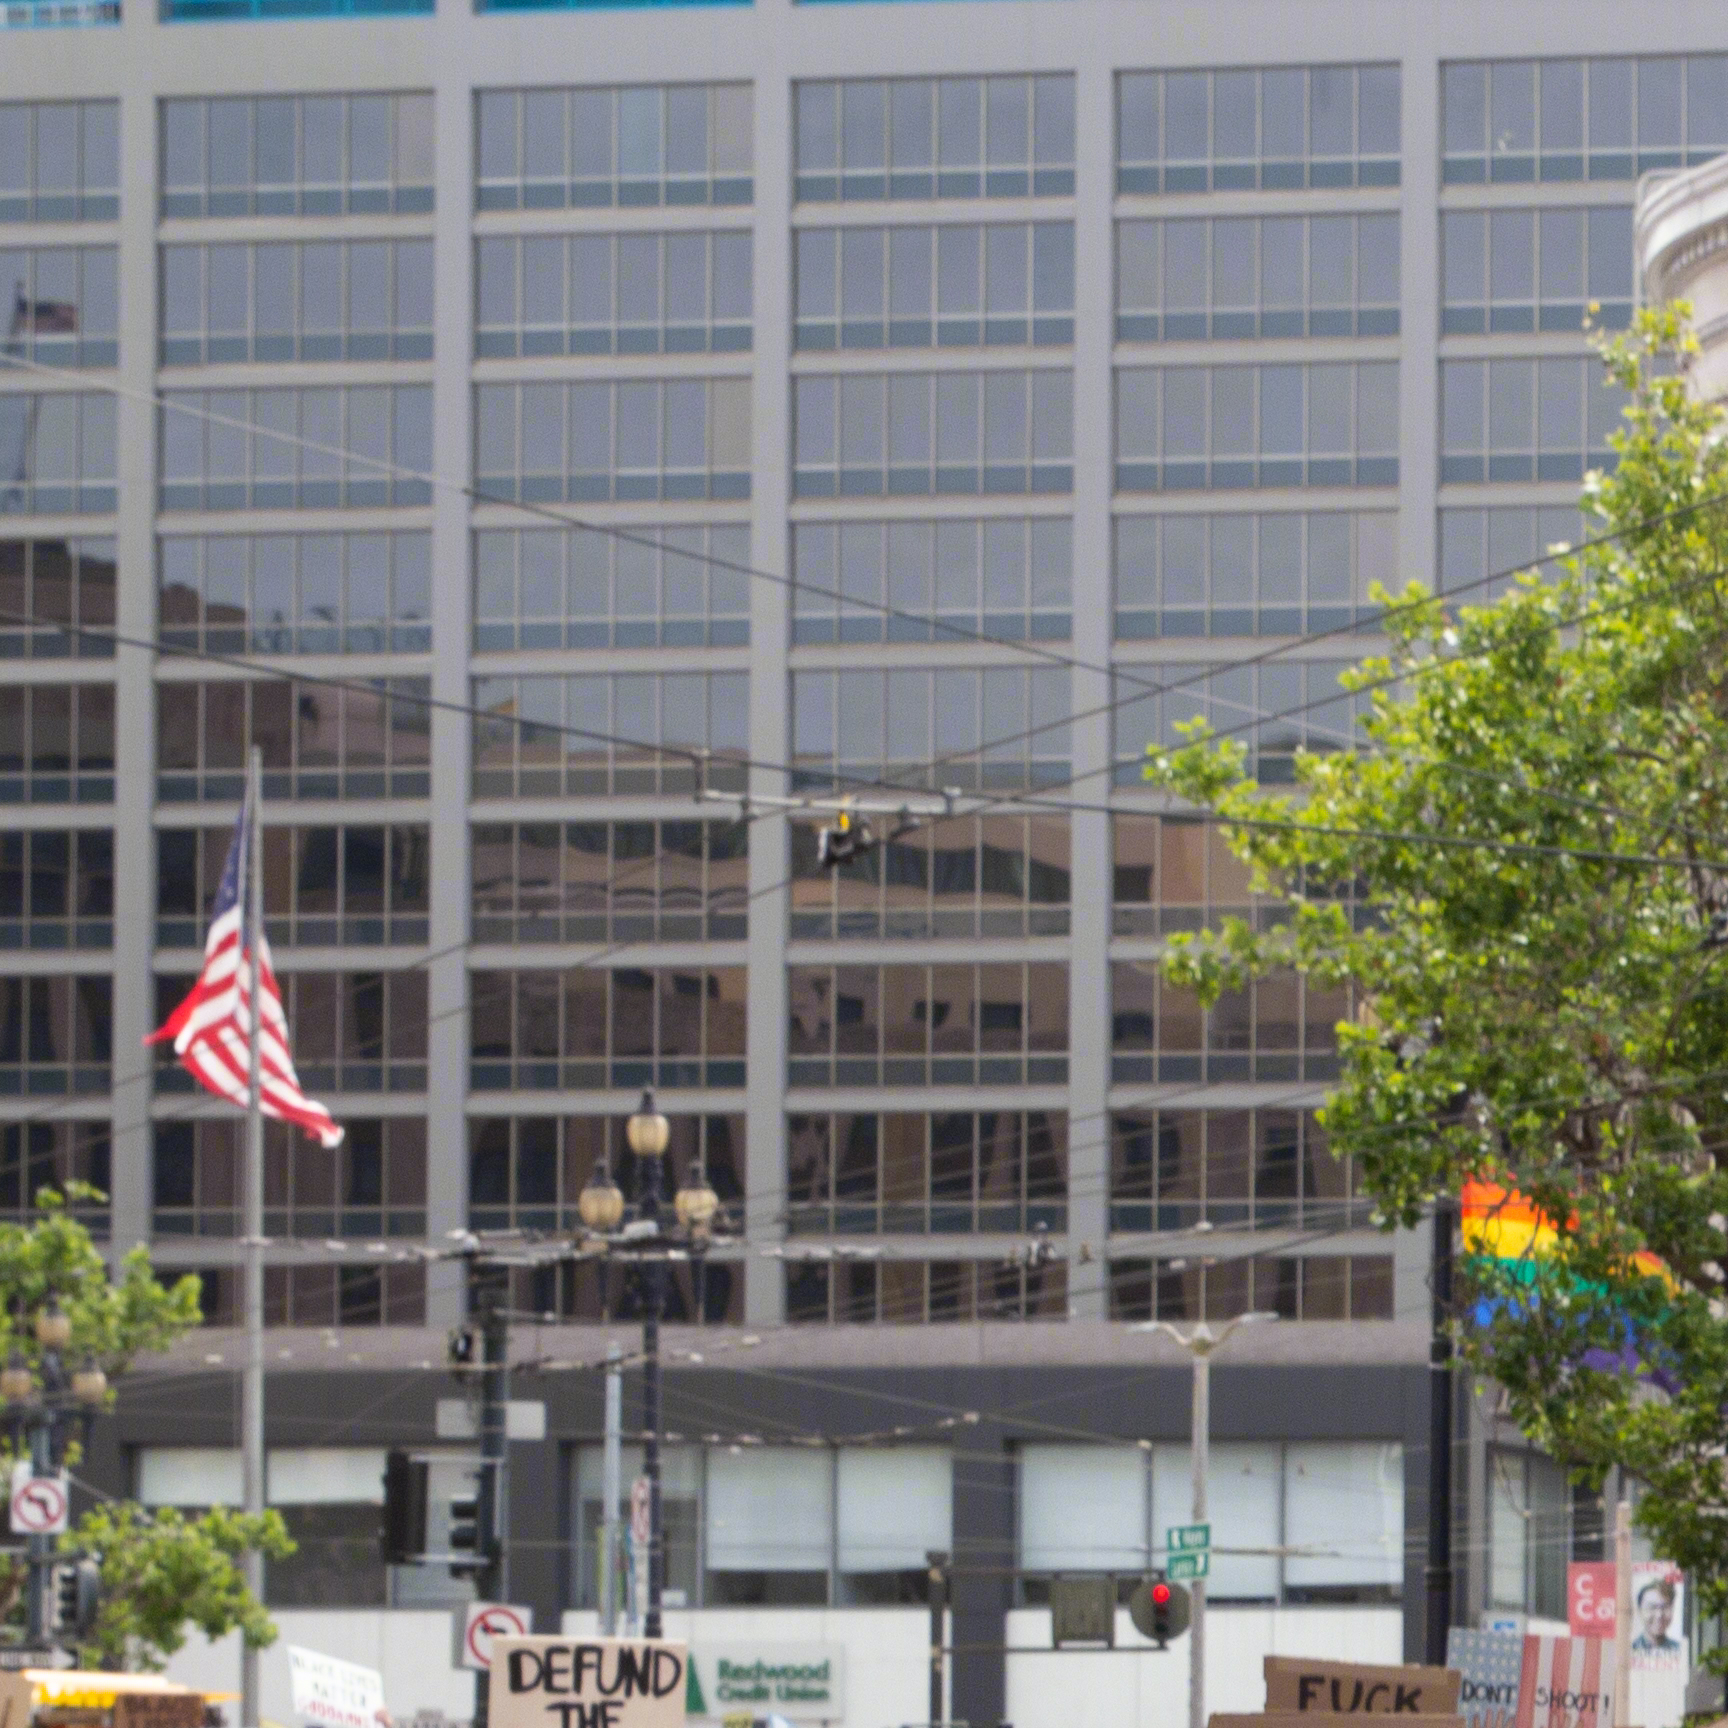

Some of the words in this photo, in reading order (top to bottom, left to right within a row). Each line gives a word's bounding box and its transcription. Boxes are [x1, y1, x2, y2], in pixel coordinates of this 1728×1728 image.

[508, 1645, 681, 1698] DEFUND
[717, 1659, 830, 1682] Redwood
[717, 1685, 770, 1701] Credit
[775, 1686, 830, 1701] Union
[1298, 1675, 1423, 1714] FUCK
